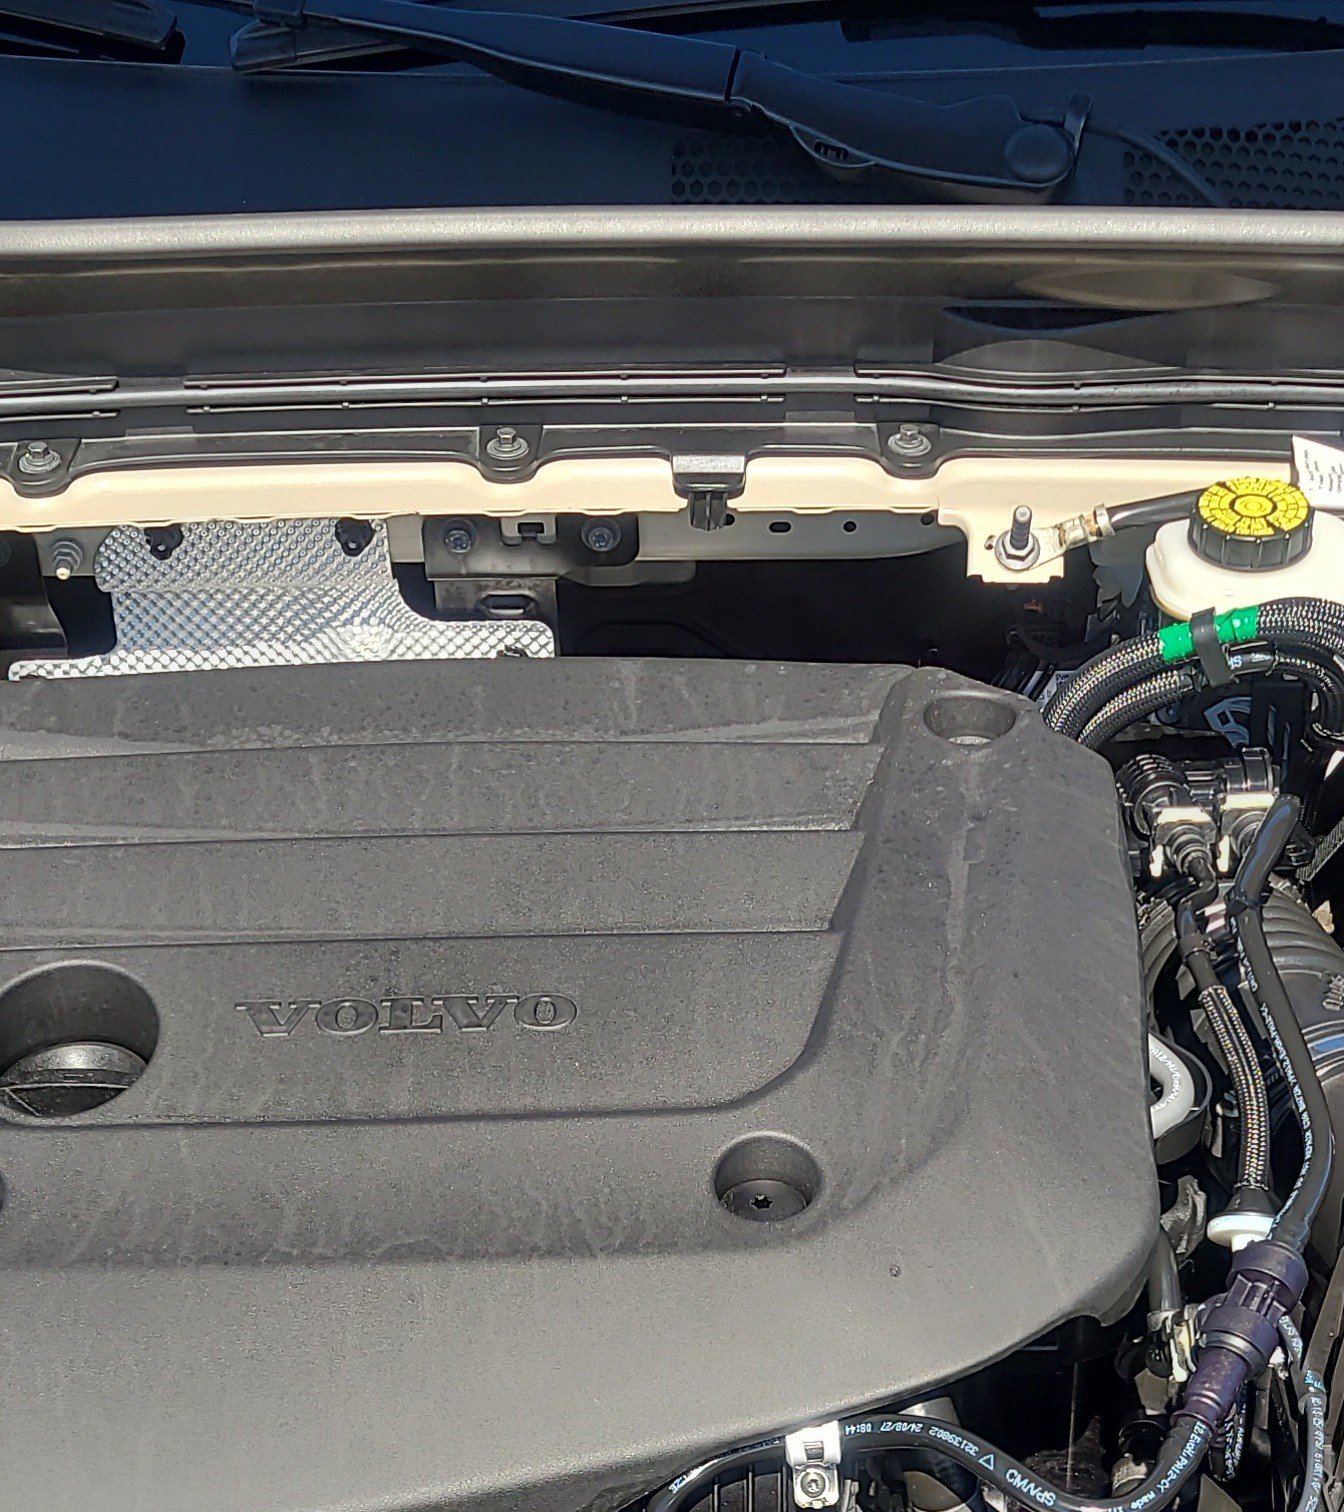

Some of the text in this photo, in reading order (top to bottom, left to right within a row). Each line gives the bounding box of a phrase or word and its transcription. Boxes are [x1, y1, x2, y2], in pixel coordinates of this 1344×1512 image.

[235, 994, 578, 1037] VOLVO
[845, 1421, 980, 1457] 32139802 24/08/27 08:44
